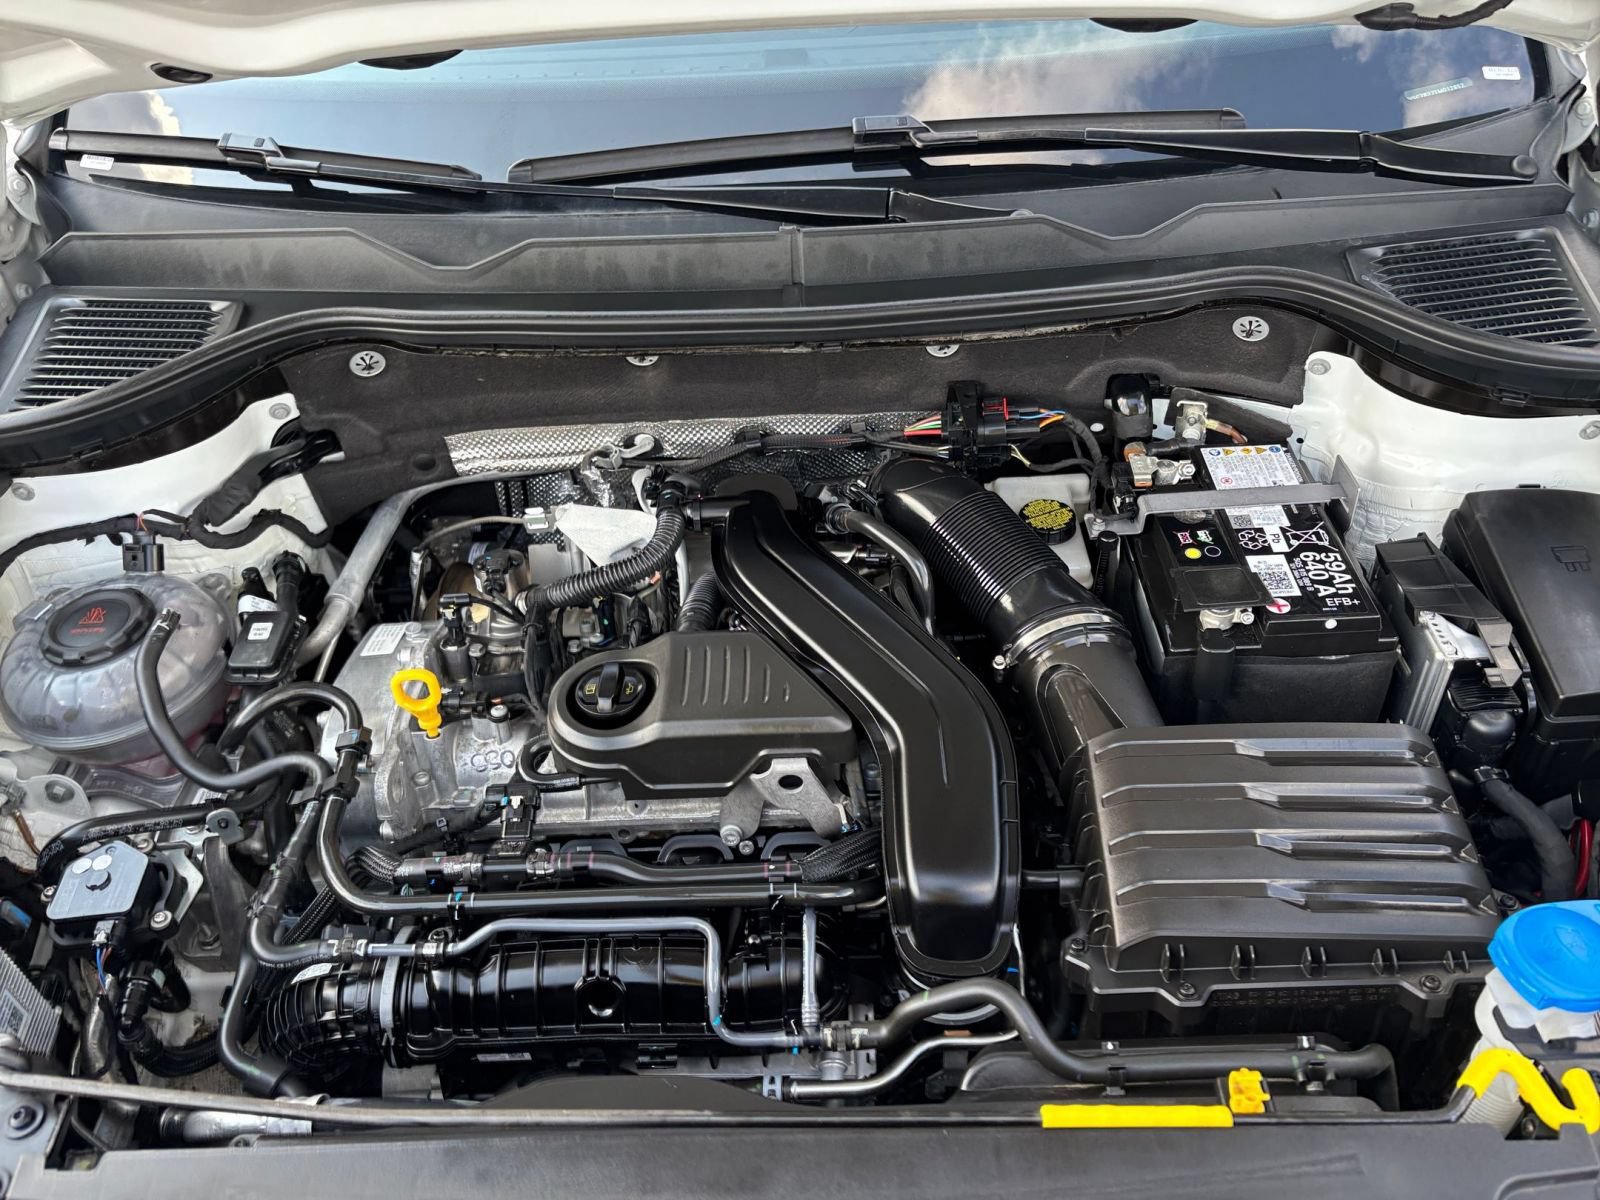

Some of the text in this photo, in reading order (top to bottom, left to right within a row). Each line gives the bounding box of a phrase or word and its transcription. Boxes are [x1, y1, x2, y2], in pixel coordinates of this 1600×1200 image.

[1270, 533, 1280, 544] Pb
[1300, 551, 1329, 580] 640
[1320, 552, 1356, 594] 59Ah
[1313, 584, 1337, 597] A
[1325, 597, 1360, 607] EFB+
